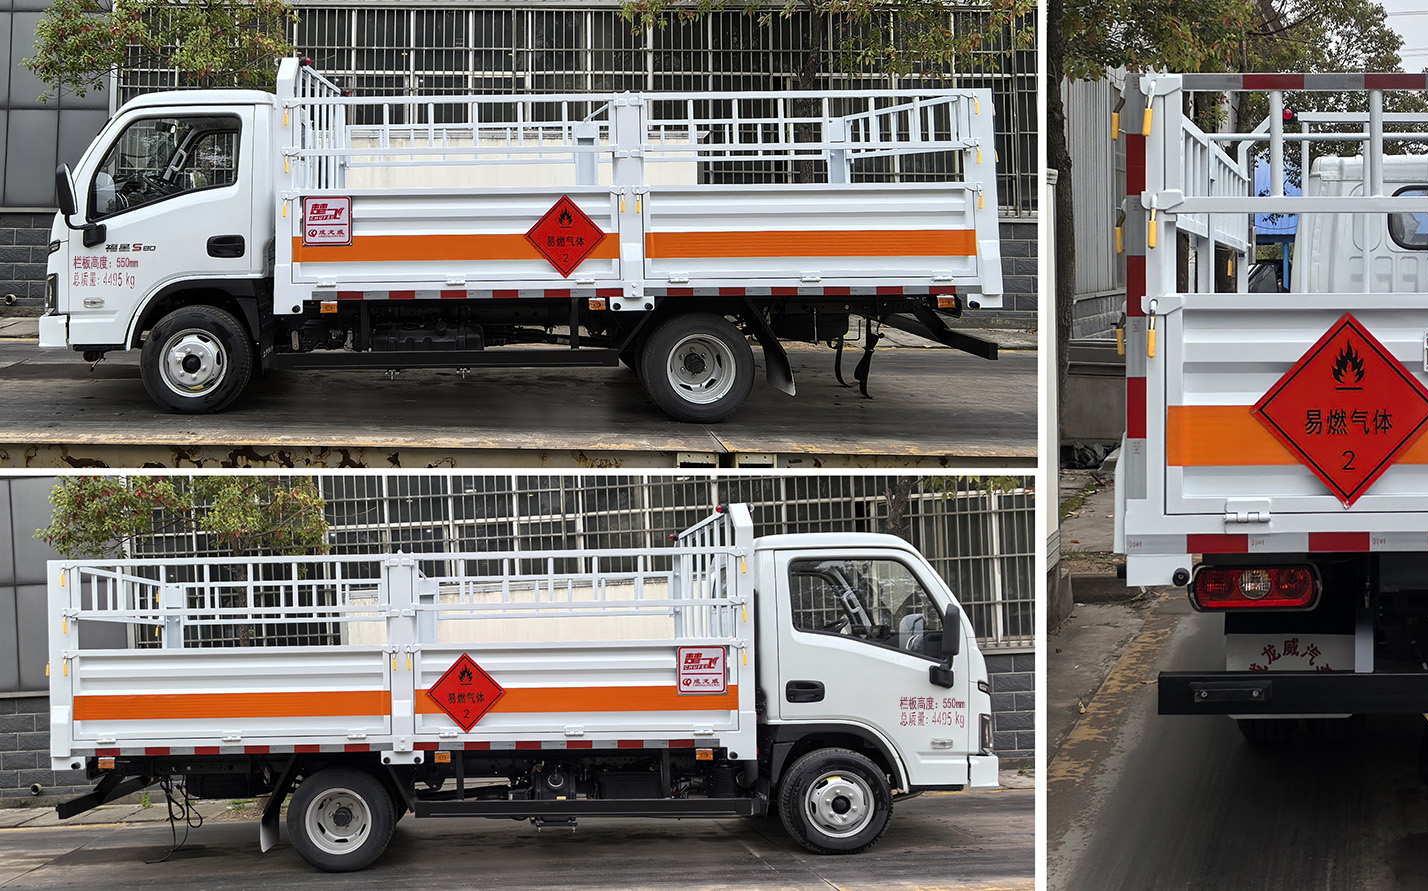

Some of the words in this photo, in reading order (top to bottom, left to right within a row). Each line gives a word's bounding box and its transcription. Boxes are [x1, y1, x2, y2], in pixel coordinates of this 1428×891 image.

[547, 236, 584, 247] 易燃气体
[563, 253, 569, 262] 2
[1305, 409, 1393, 435] 易燃气体
[1342, 450, 1355, 470] 2
[448, 693, 485, 703] 易燃气体
[464, 710, 470, 718] 2
